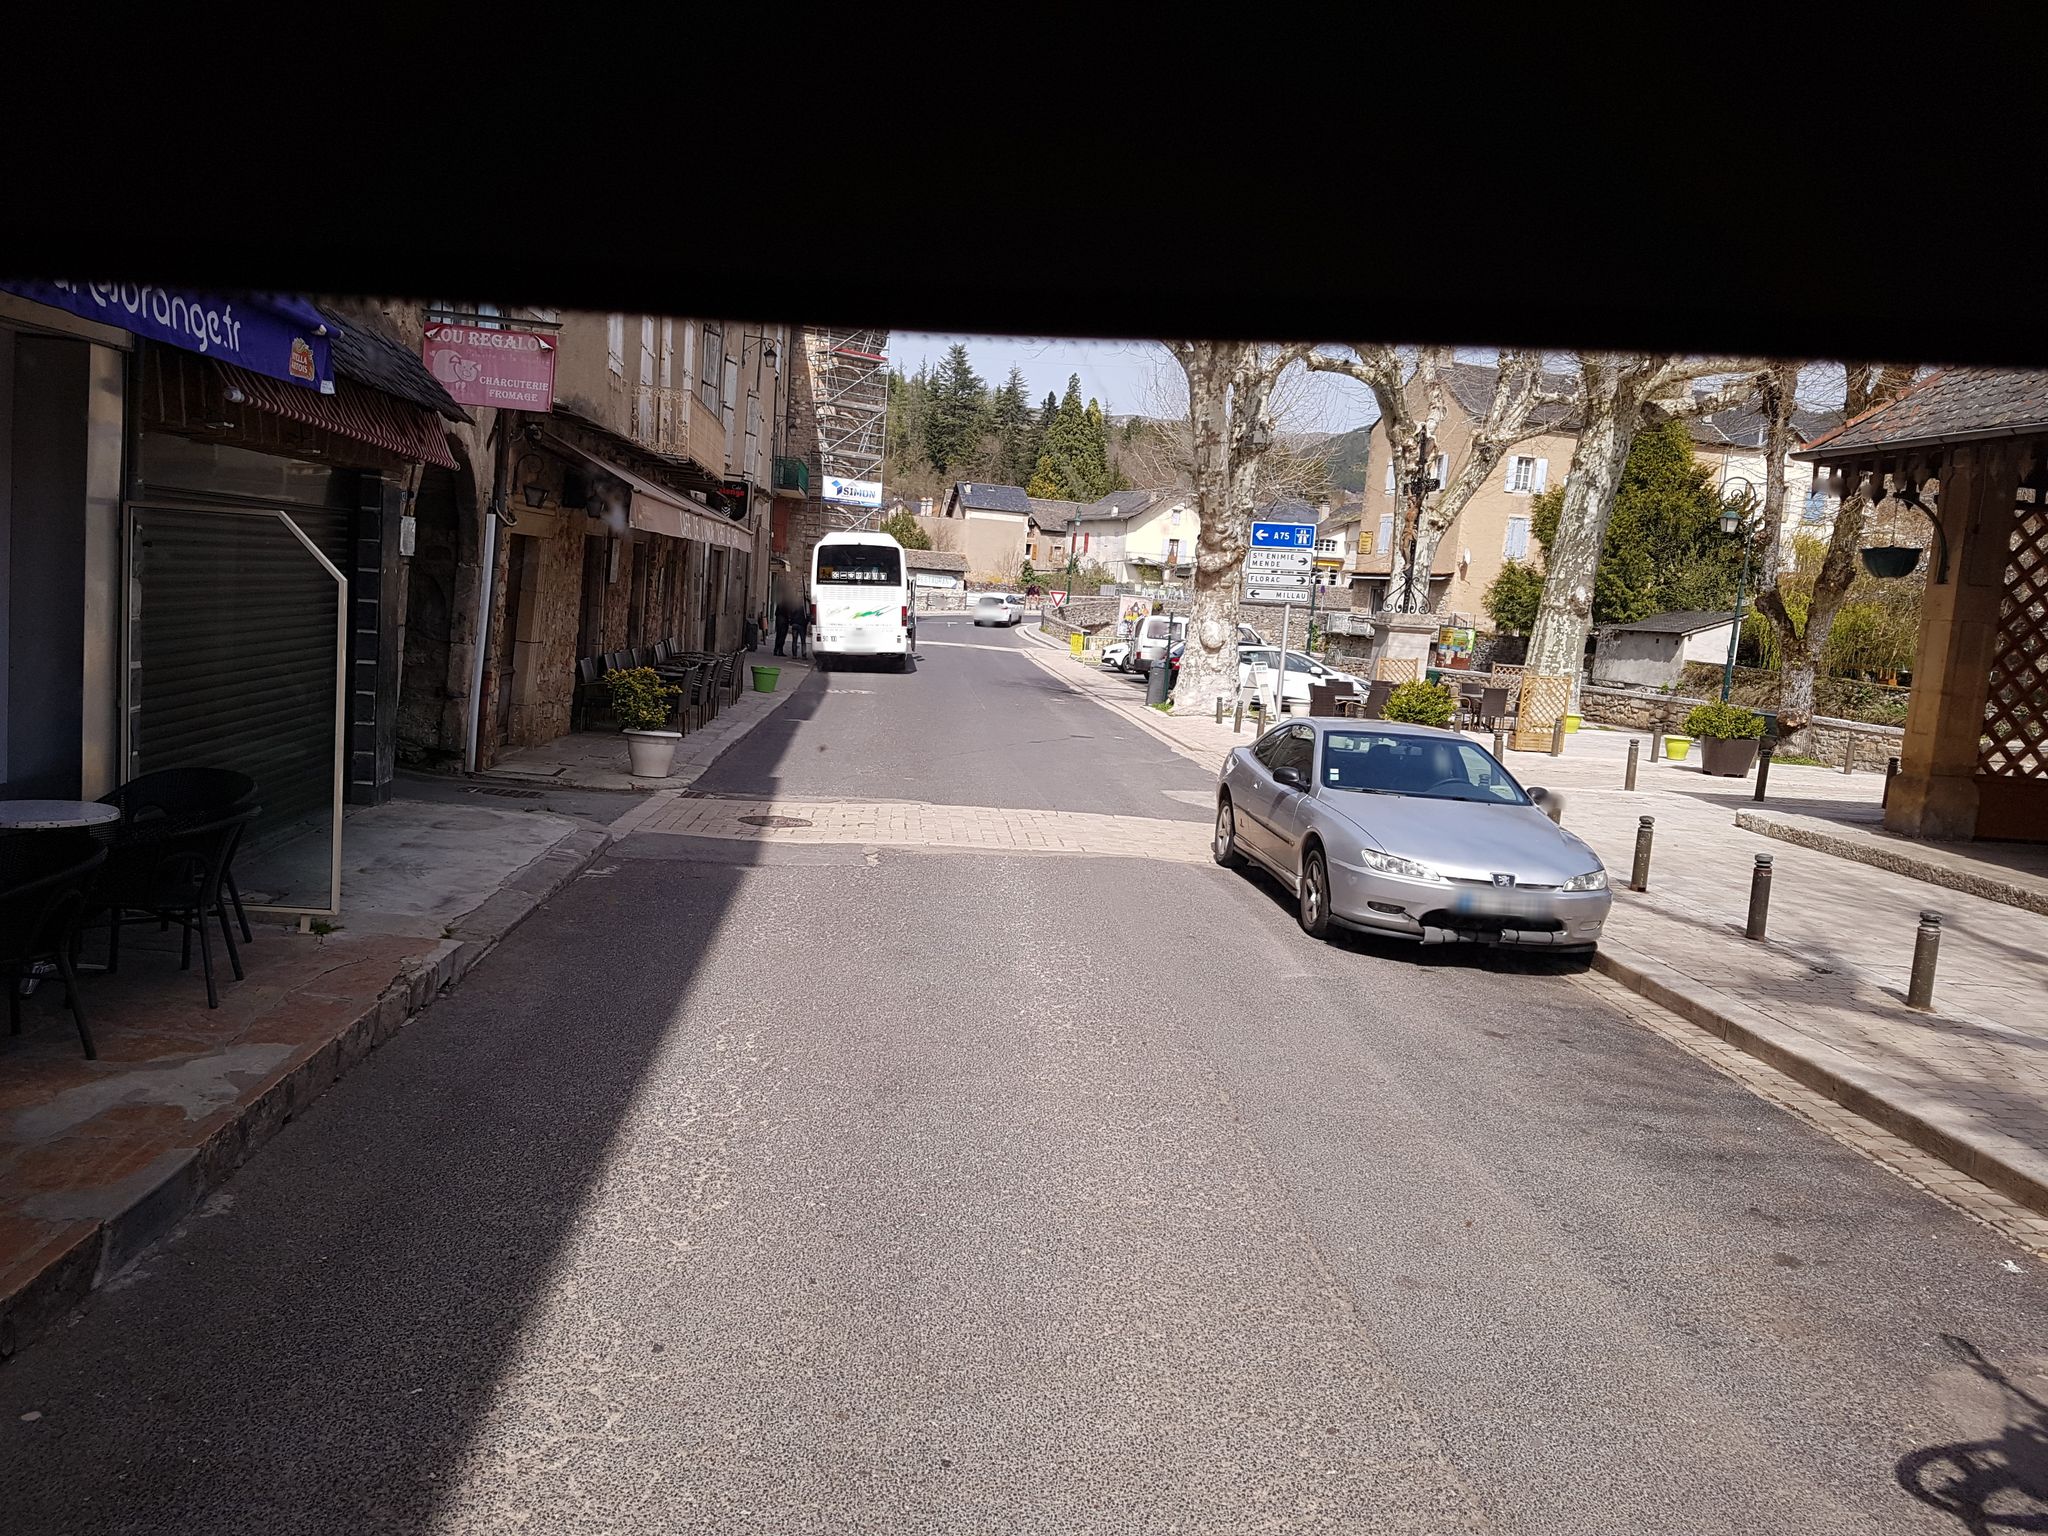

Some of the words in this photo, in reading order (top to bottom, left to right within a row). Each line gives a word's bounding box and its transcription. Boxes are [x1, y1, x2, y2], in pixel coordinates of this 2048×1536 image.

[53, 278, 242, 353] @orange.fr
[430, 327, 464, 344] LOU
[468, 331, 548, 352] REGALO
[479, 376, 549, 391] CHARCUTERIE
[489, 389, 538, 402] FROMAGE
[842, 487, 875, 498] SIMON
[1273, 532, 1290, 540] A75
[1252, 560, 1281, 568] MENDE
[1275, 592, 1306, 600] MILLAU
